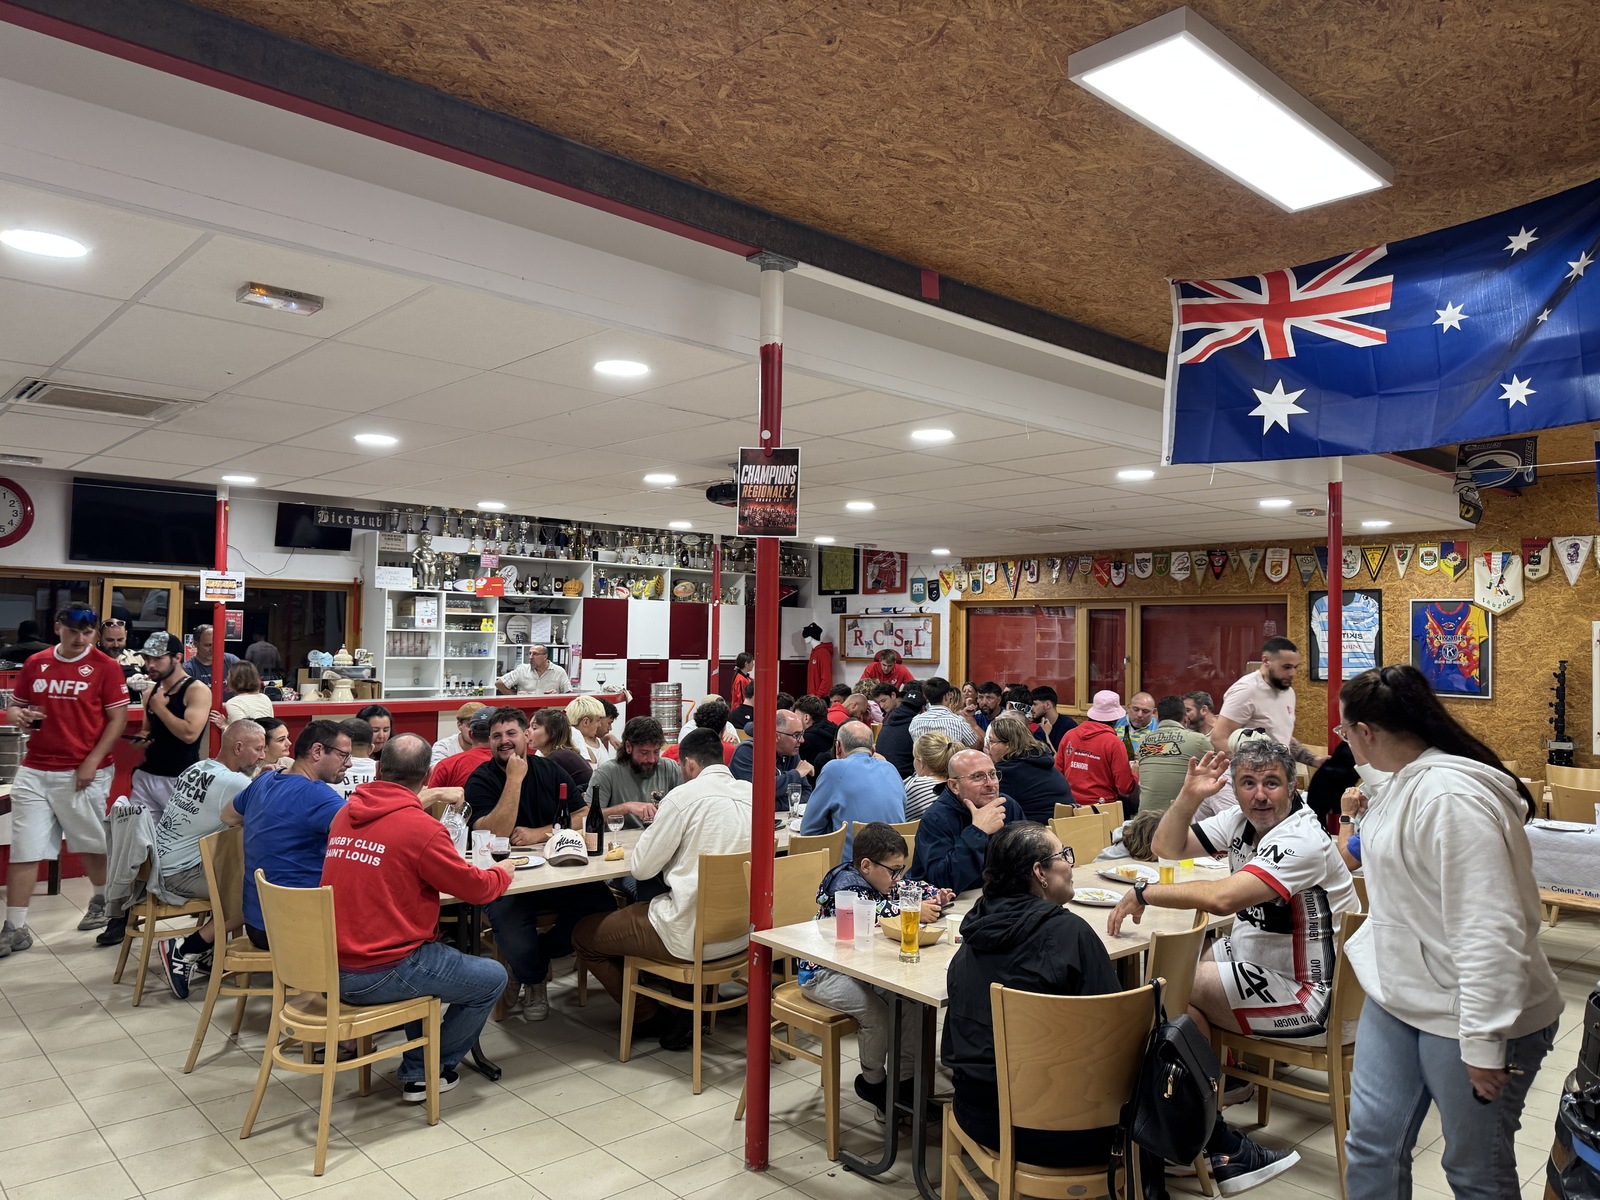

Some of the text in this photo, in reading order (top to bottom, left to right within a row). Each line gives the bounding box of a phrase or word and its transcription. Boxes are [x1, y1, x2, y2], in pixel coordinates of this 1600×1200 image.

[741, 465, 797, 484] CHAMPIONS
[789, 485, 796, 498] 2
[9, 500, 16, 508] 2
[12, 509, 19, 517] 3
[318, 509, 383, 528] Bierstub
[1342, 632, 1364, 640] TIXIS
[48, 679, 89, 695] NFP
[329, 836, 386, 854] RUGBY CLUB
[325, 848, 381, 866] SAINT LOUIS
[1584, 890, 1600, 899] Mut
[1273, 1017, 1300, 1029] RUGBY
